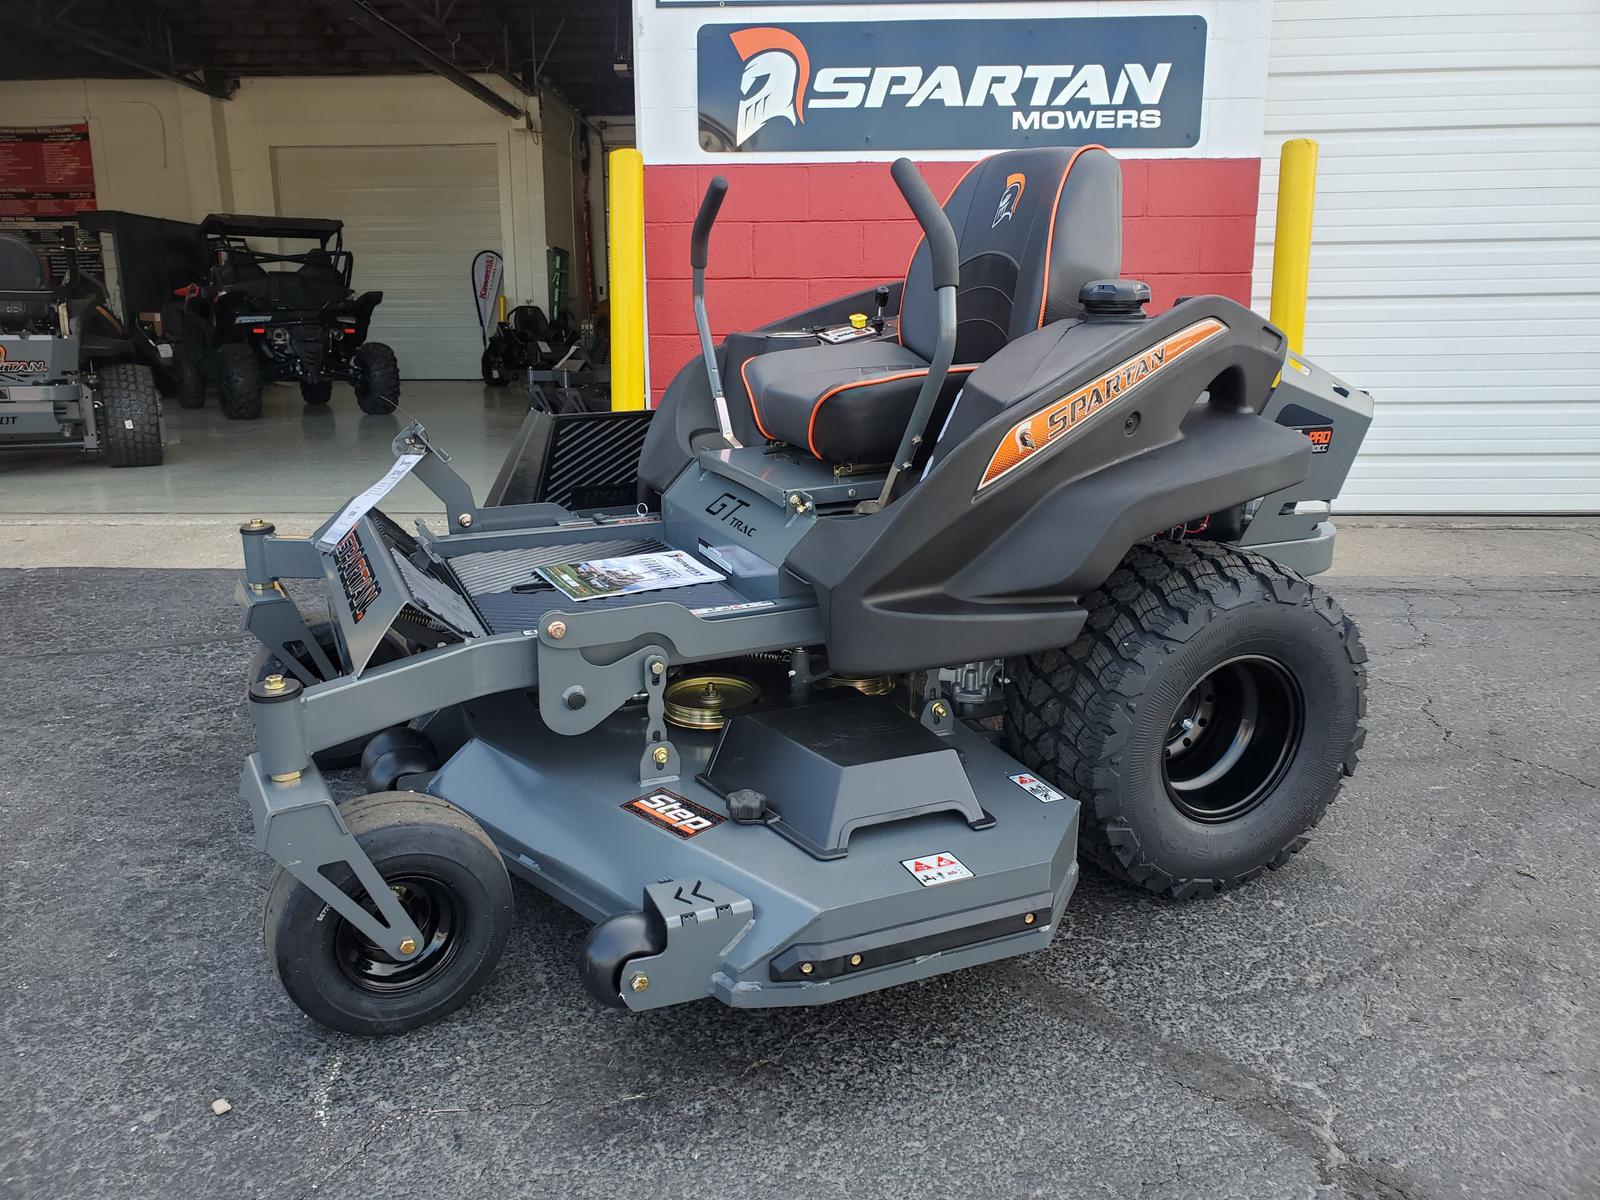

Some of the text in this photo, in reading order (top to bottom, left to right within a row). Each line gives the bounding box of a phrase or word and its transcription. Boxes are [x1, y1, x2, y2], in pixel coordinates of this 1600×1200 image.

[808, 62, 1173, 110] SPARTAN
[1012, 109, 1162, 131] MOWERS
[1048, 347, 1166, 439] SPARTAN
[1309, 431, 1331, 444] PRO
[705, 493, 750, 521] GT
[730, 517, 757, 537] TRAC
[335, 531, 381, 617] SPARTAN
[638, 794, 712, 830] Step
